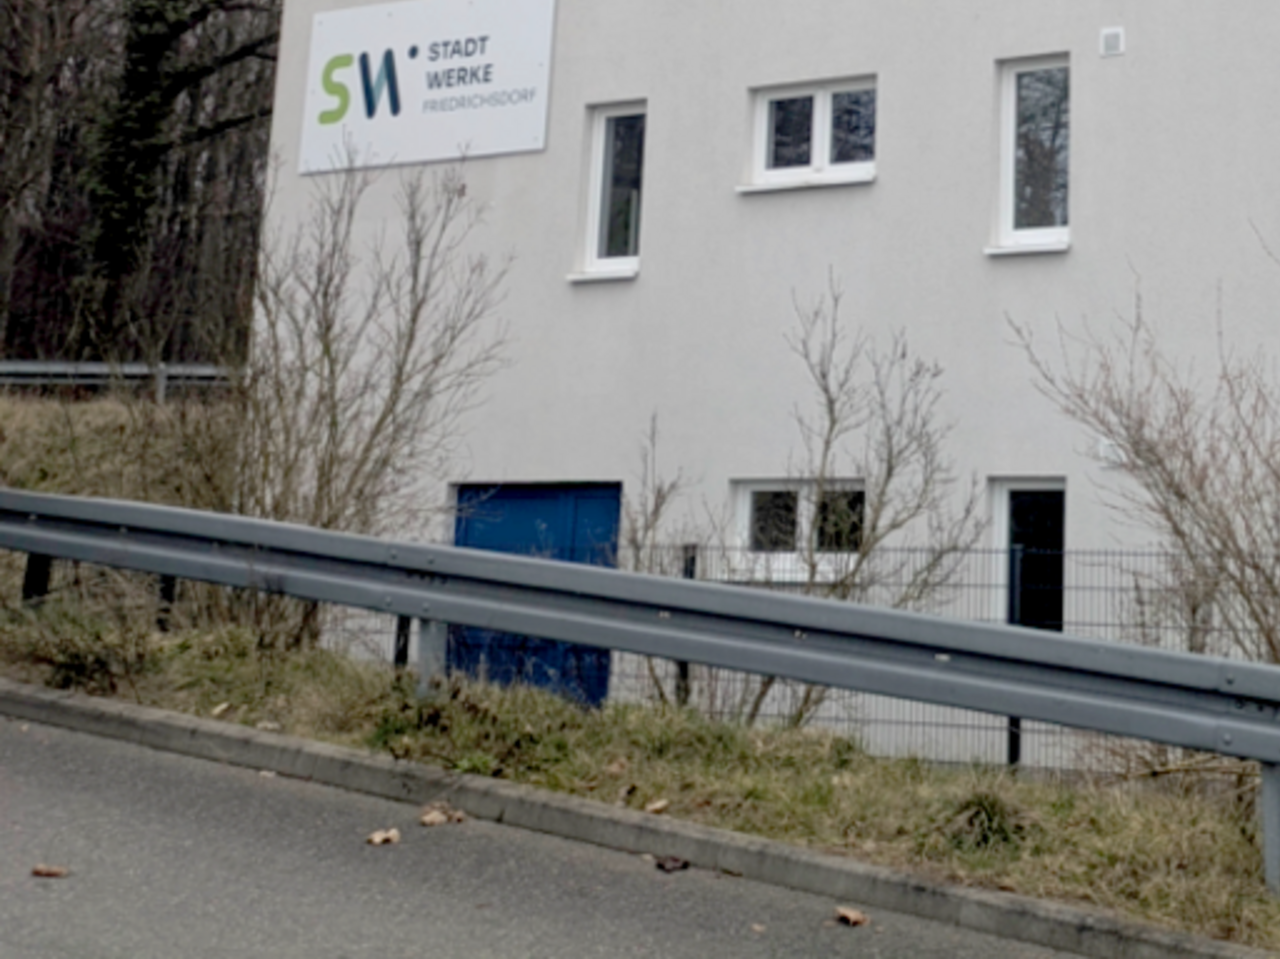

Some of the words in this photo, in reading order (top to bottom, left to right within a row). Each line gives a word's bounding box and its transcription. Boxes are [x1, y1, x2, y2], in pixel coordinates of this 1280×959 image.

[427, 35, 490, 61] STADT
[425, 63, 494, 90] WERKE
[422, 87, 537, 113] FRIEDRICHSDORF
